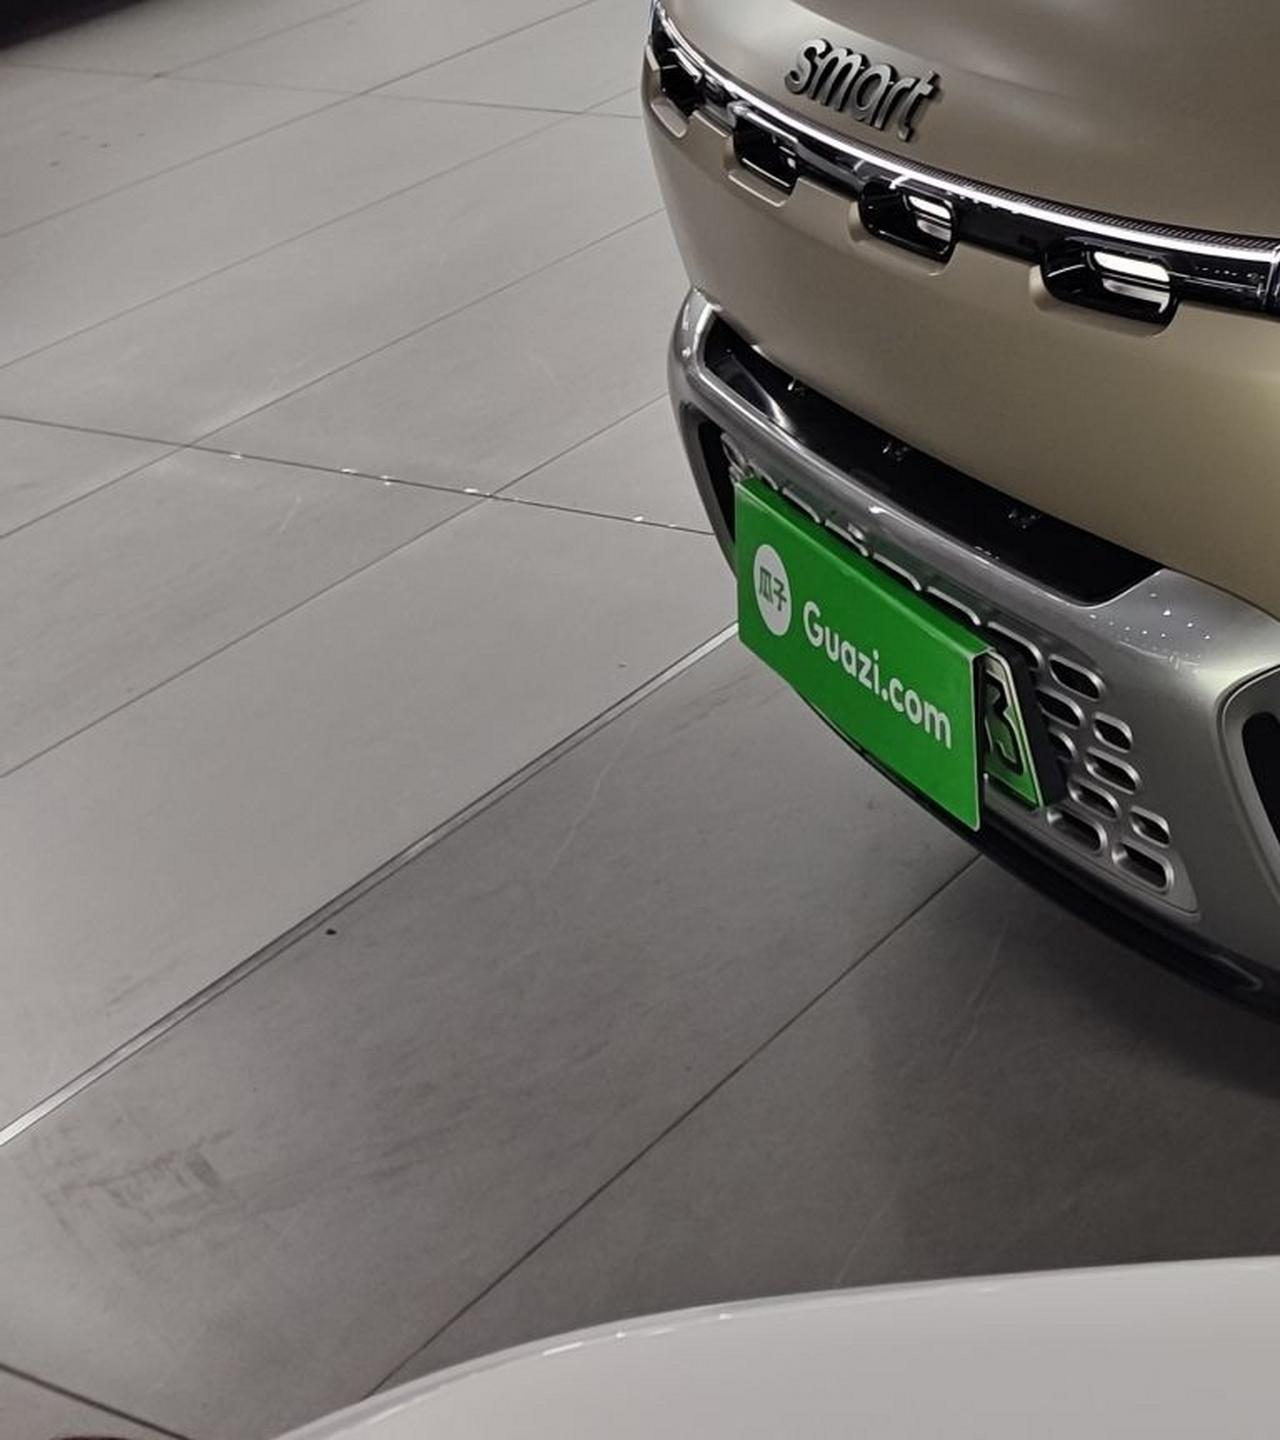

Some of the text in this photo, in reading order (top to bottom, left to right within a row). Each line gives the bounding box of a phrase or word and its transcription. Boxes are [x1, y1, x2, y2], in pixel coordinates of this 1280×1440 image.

[785, 38, 943, 142] smart
[758, 565, 788, 611] 瓜子
[803, 600, 952, 750] Guazi.com
